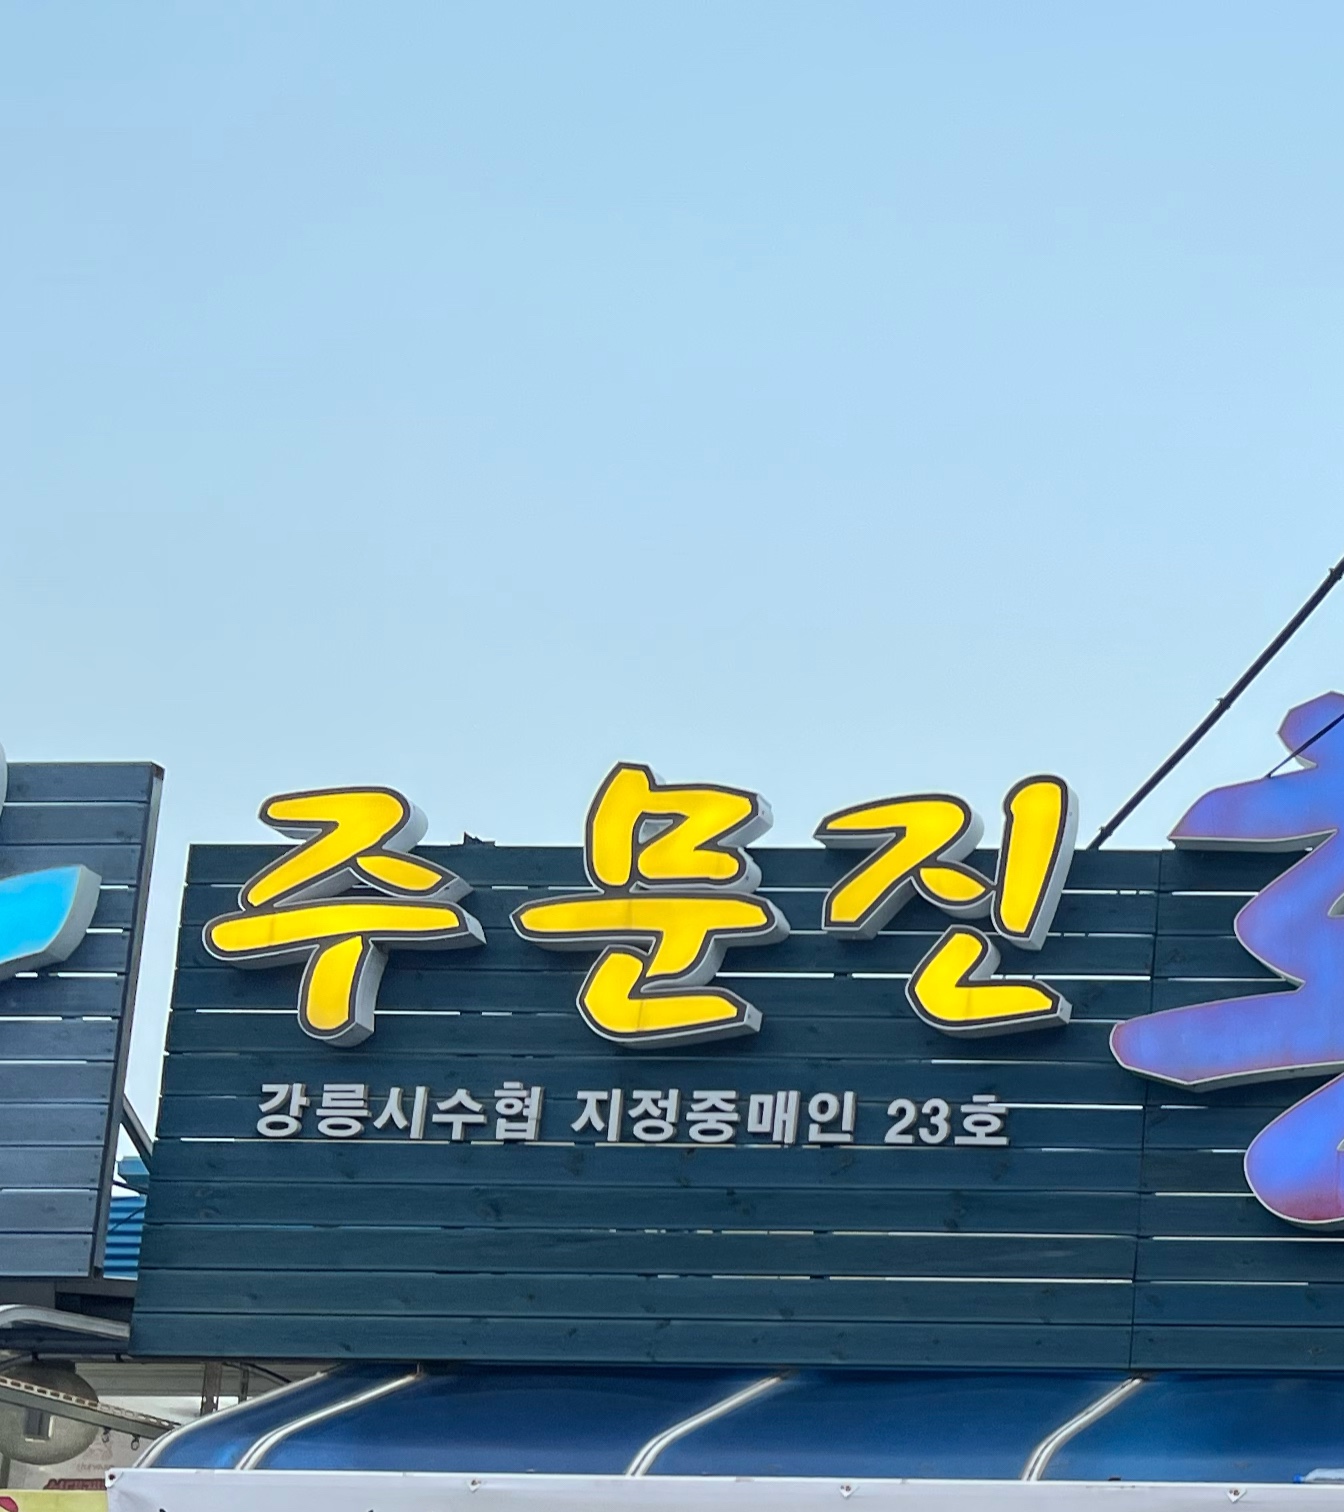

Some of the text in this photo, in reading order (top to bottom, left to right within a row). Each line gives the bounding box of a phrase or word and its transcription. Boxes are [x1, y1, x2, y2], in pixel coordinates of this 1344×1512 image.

[201, 760, 1080, 1048] 주문진
[256, 1081, 1010, 1147] 강릉시수협 지정중매인 23호
